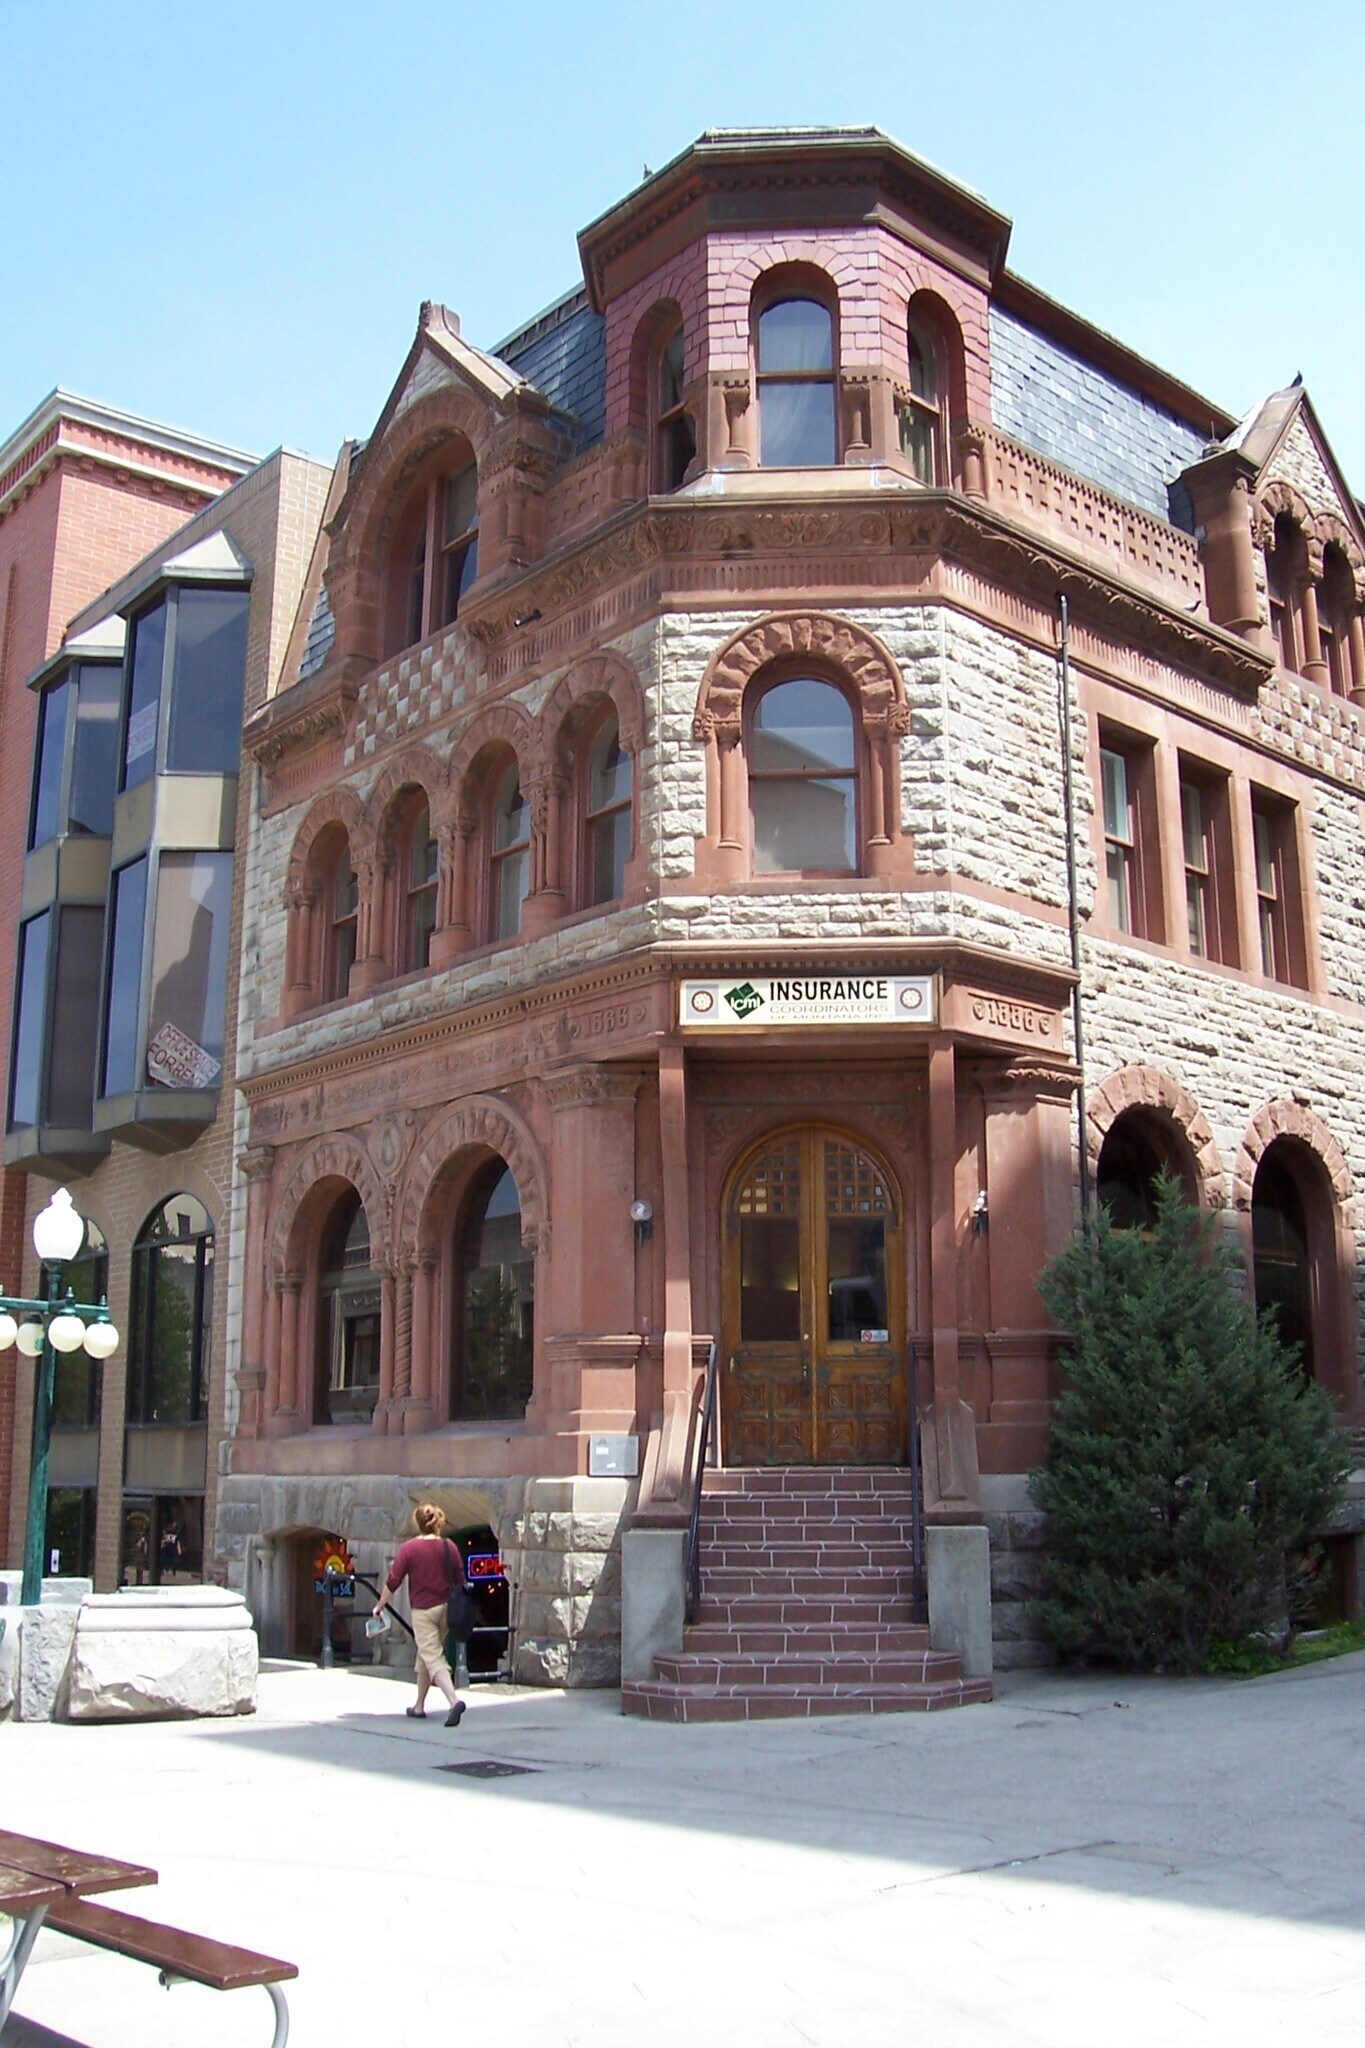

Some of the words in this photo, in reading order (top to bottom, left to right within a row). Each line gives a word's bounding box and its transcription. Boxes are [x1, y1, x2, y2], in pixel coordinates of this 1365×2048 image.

[770, 980, 888, 1001] INSURANCE
[769, 1004, 888, 1014] COORDINATORS
[149, 1042, 178, 1074] FOR
[159, 1024, 193, 1057] OFFICE
[185, 1047, 219, 1079] SPACE
